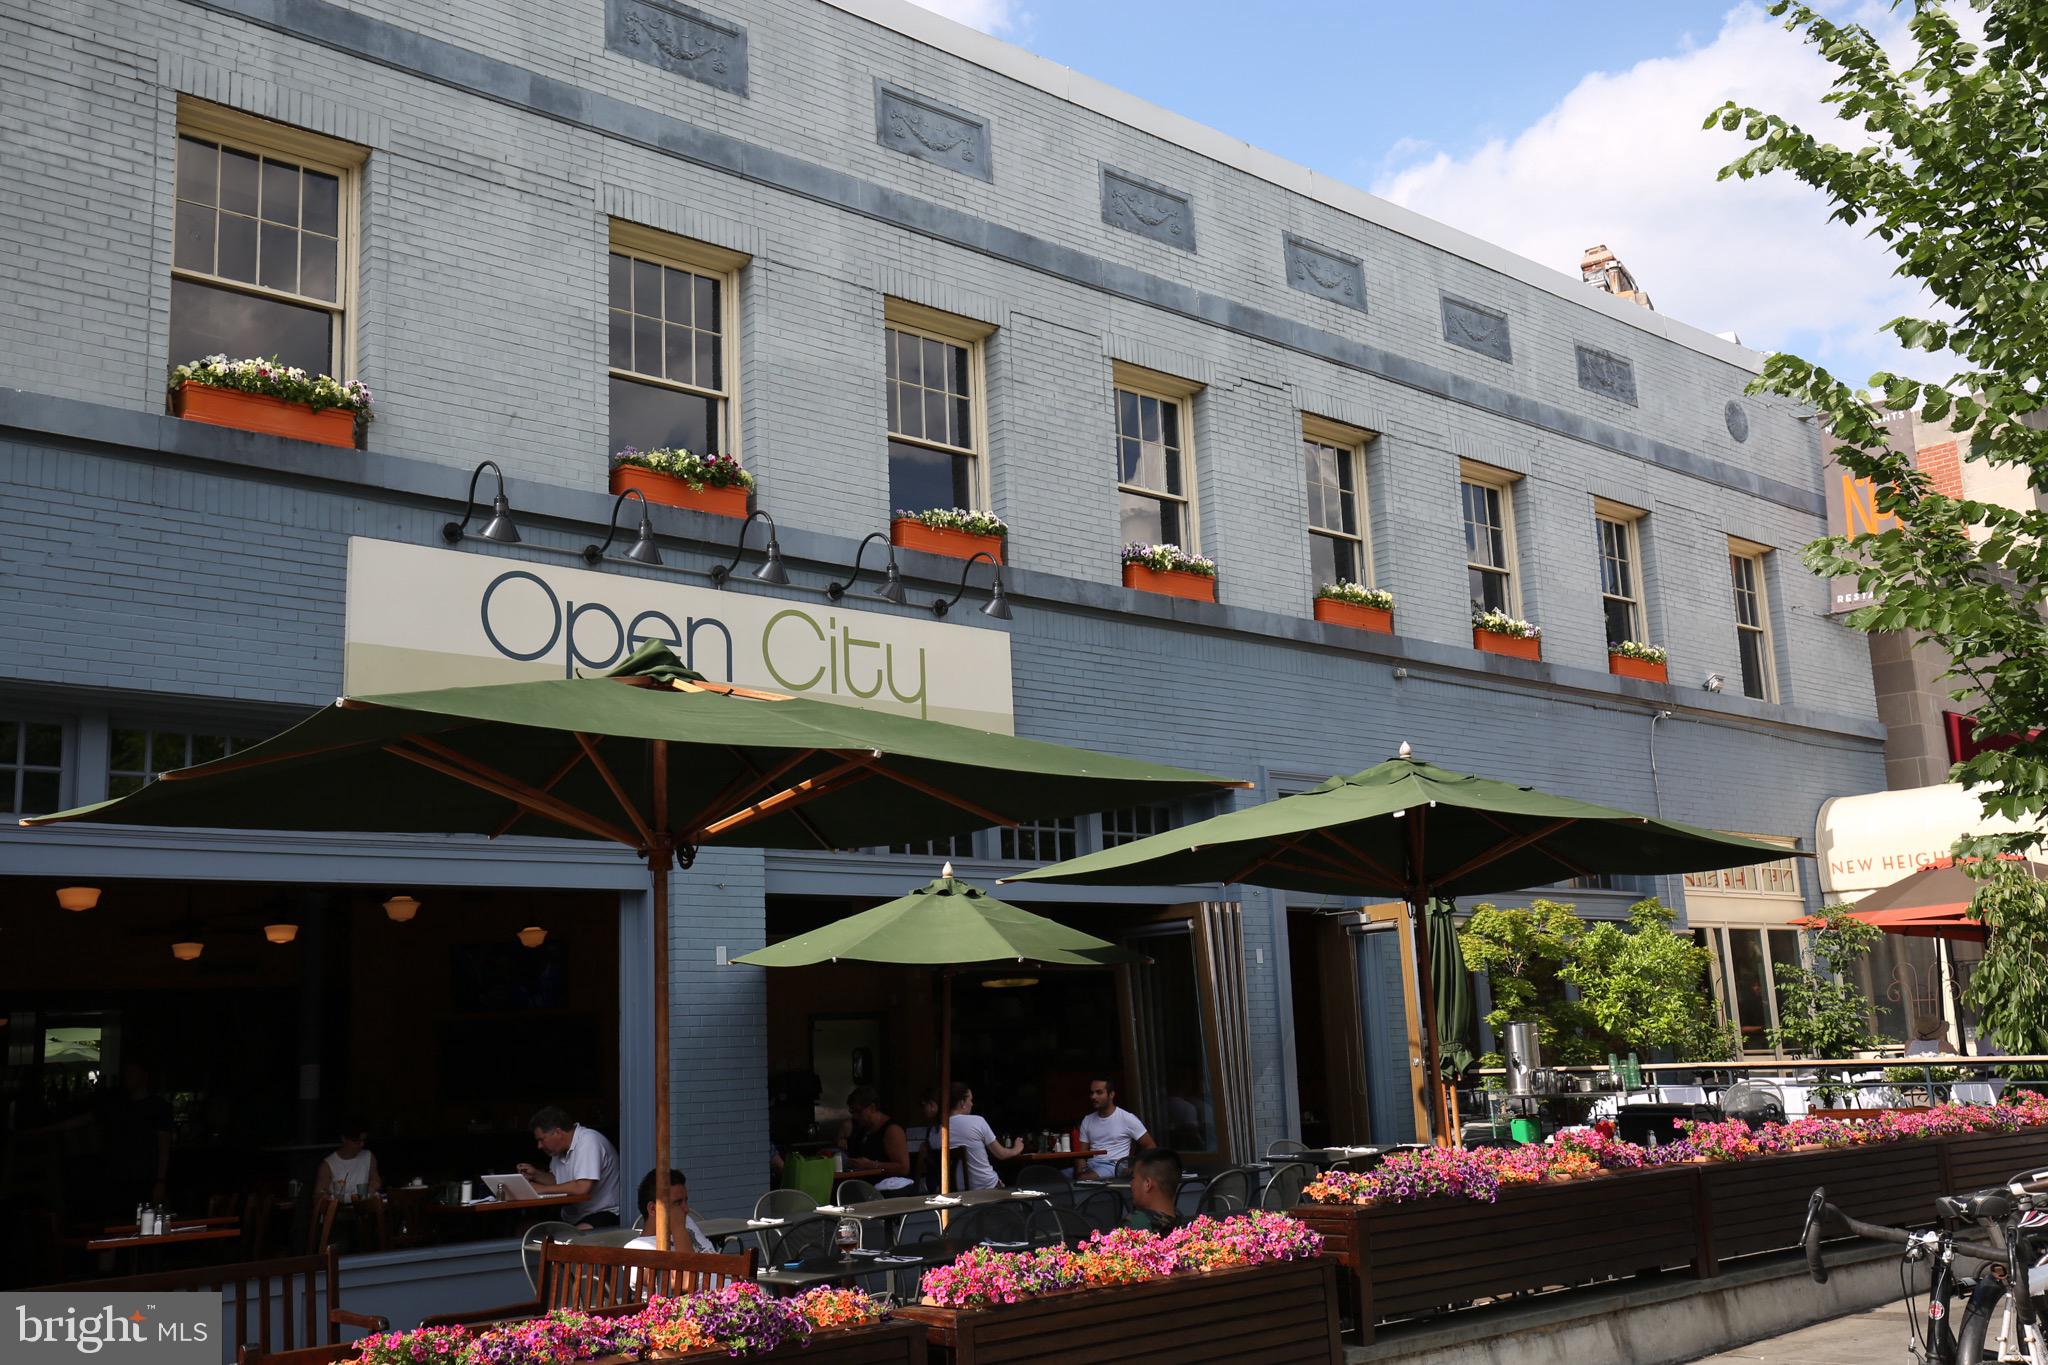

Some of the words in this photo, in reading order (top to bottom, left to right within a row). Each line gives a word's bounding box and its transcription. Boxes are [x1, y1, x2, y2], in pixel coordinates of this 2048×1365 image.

[481, 571, 733, 682] Open
[762, 609, 927, 720] City
[1831, 858, 1873, 875] NEW
